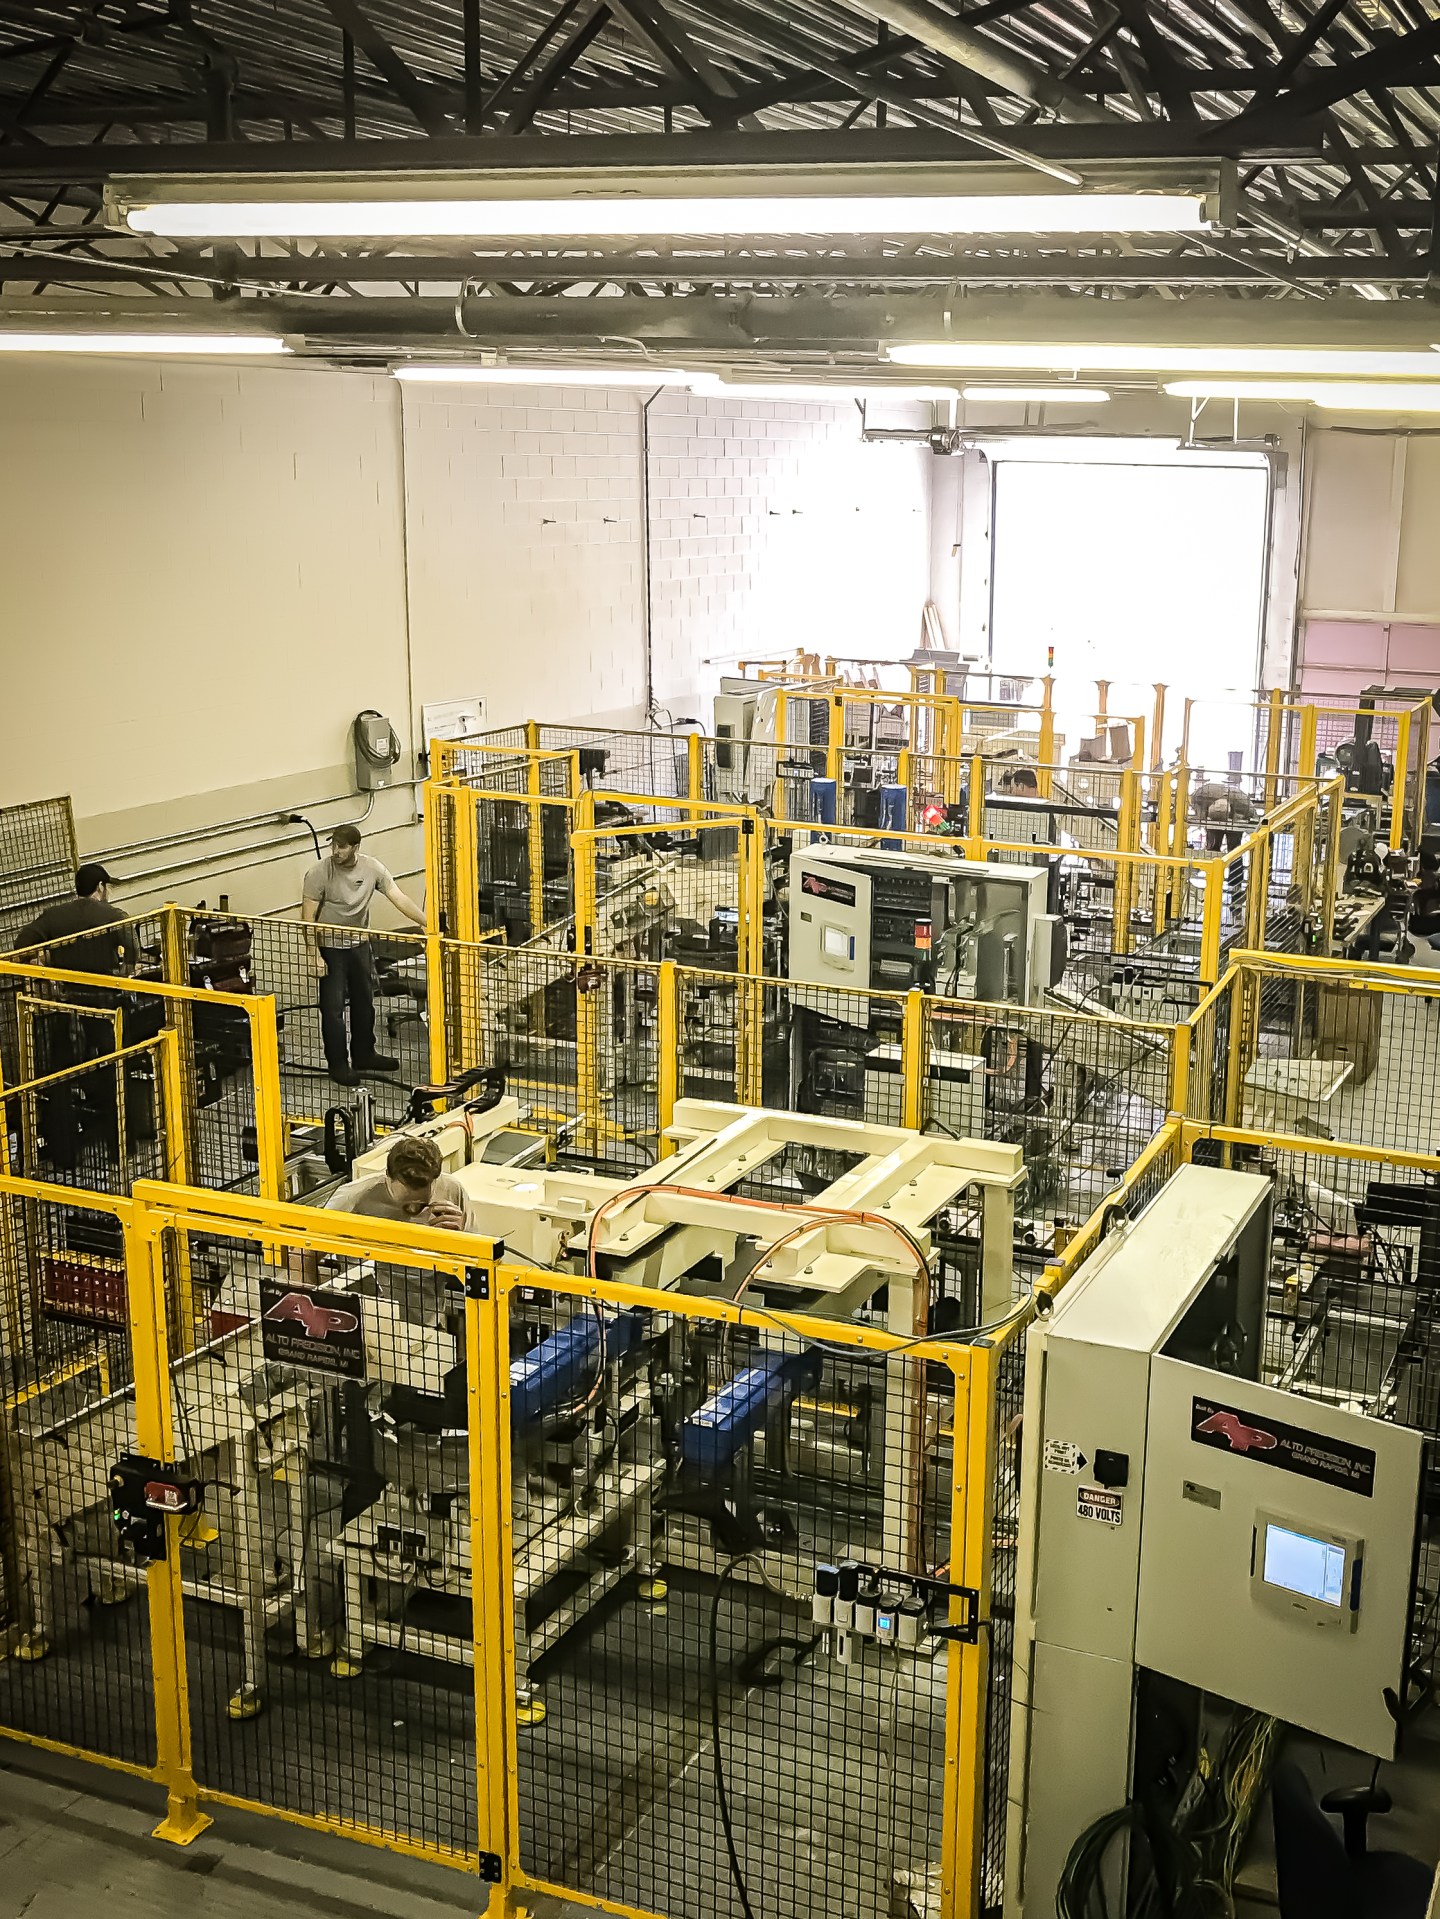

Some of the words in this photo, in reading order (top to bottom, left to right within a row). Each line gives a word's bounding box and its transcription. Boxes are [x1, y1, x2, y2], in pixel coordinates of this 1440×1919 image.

[265, 1333, 289, 1346] ALTO
[278, 1347, 306, 1360] GRAND
[1279, 1439, 1304, 1452] ALTO
[1291, 1451, 1319, 1465] GRAND
[1083, 1492, 1116, 1505] DANGER
[1078, 1504, 1094, 1518] 480
[1095, 1507, 1121, 1523] VOLTS
